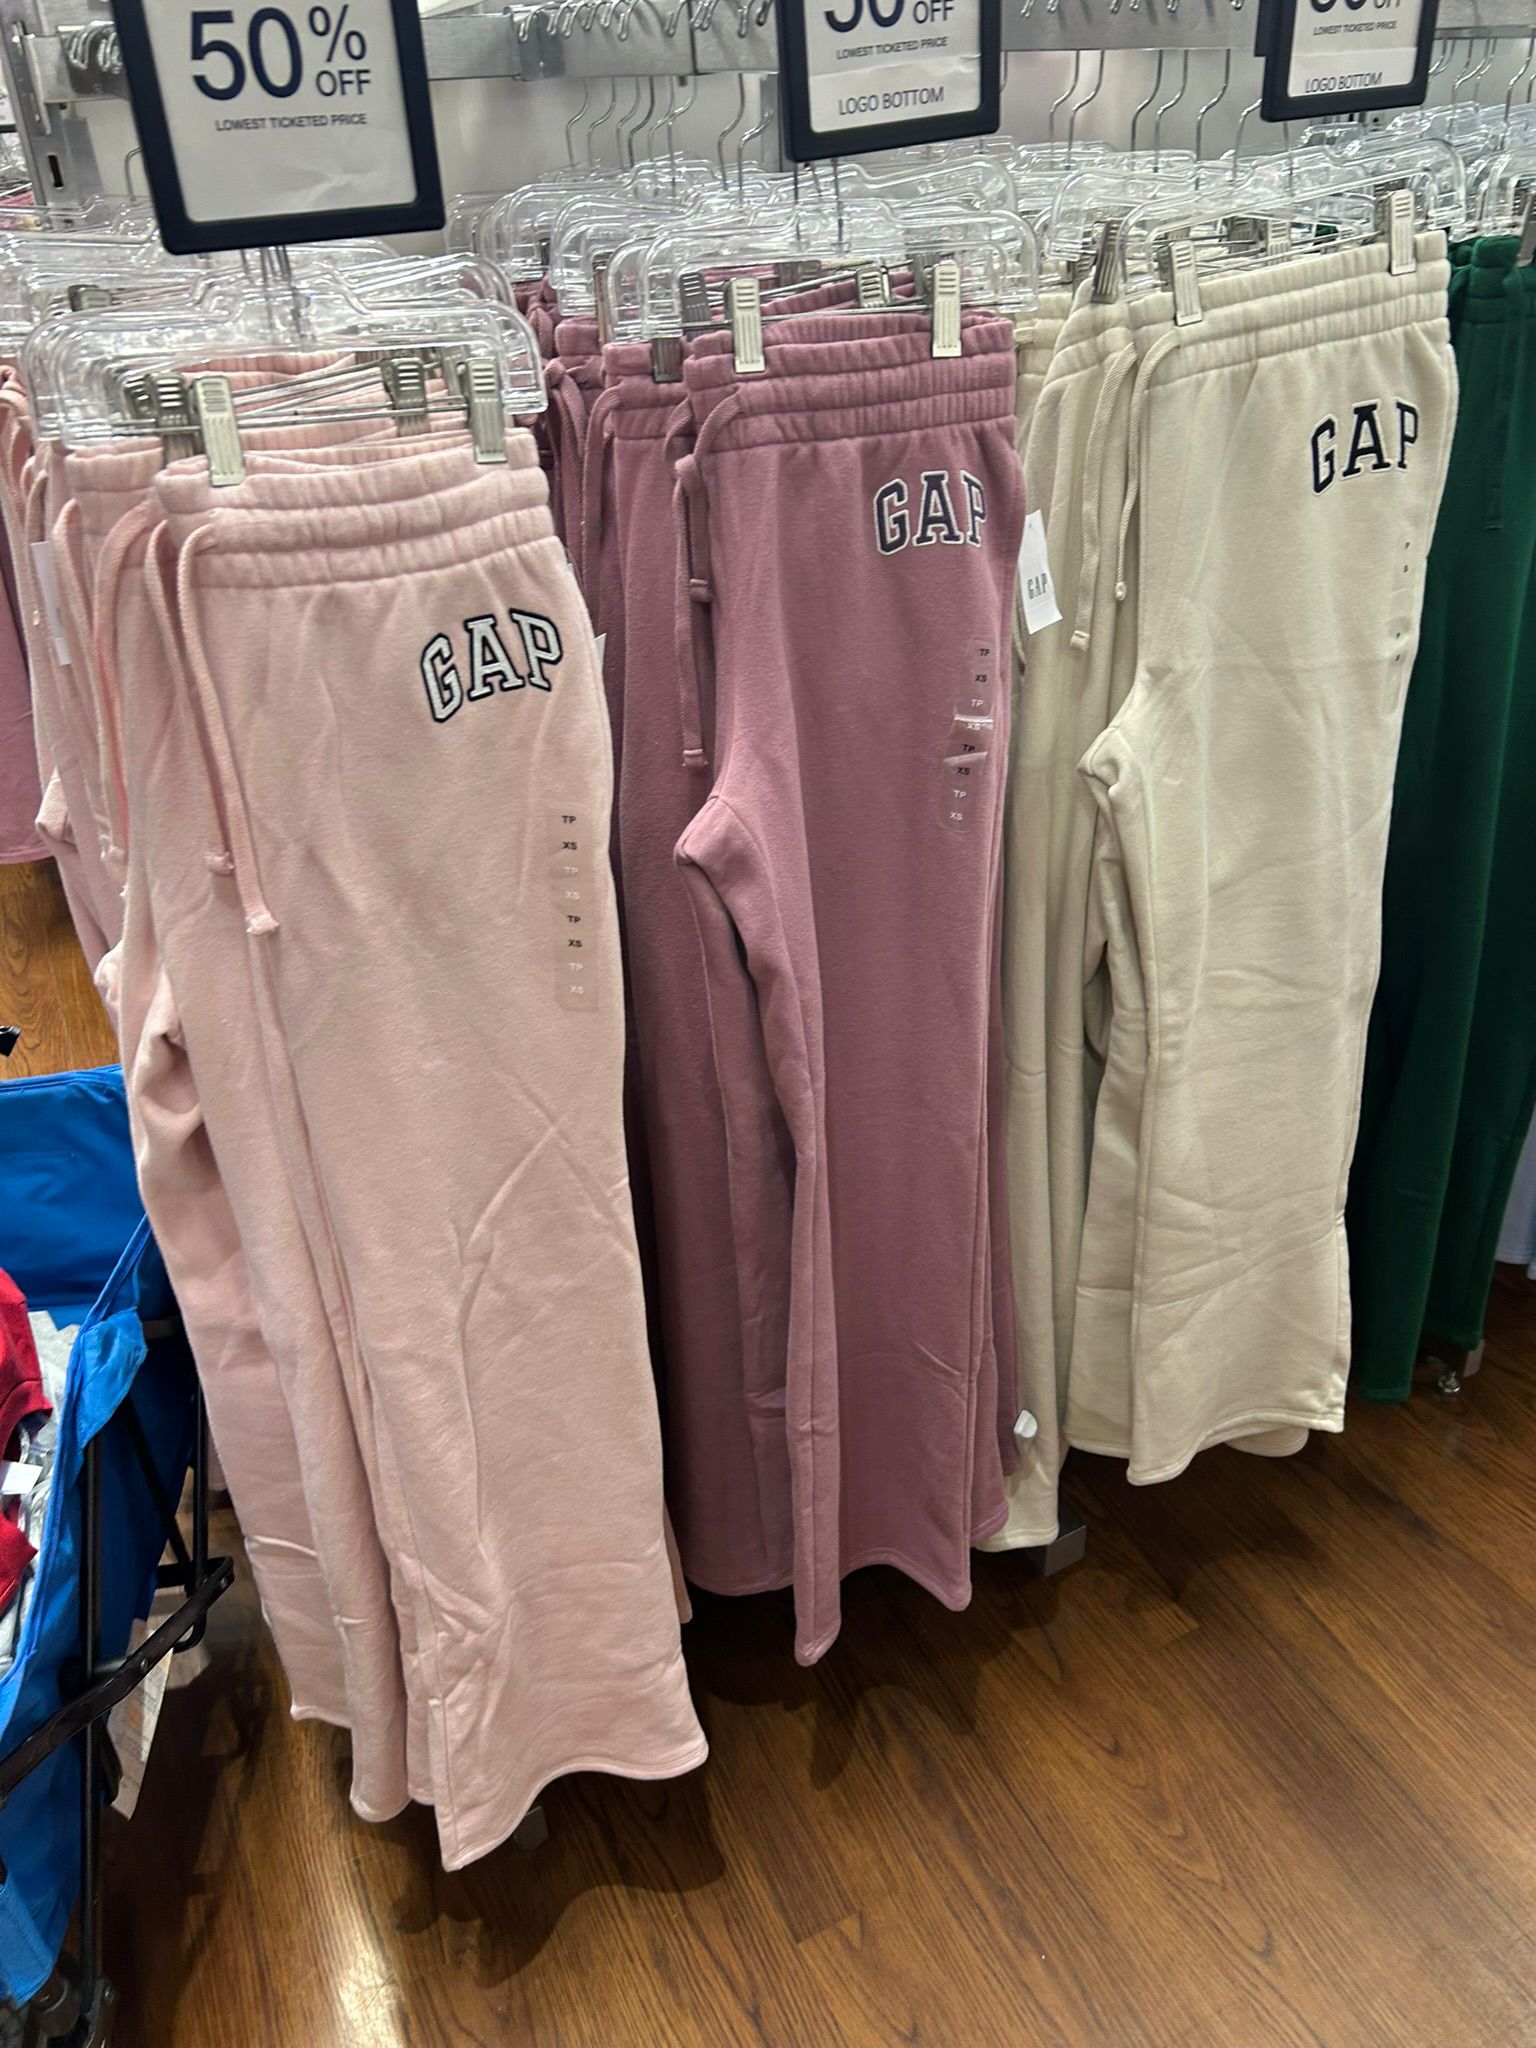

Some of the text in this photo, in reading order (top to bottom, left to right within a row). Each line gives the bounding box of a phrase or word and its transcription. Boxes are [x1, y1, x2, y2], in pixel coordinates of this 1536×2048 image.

[913, 0, 954, 24] OFF
[837, 36, 948, 60] LOWEST TICKETED PRICE
[316, 69, 371, 97] OFF
[1305, 72, 1383, 93] LOGO BOTTOM
[838, 86, 944, 116] LOGO BOTTOM
[215, 112, 367, 132] LOWEST TICKETED PRICE
[1311, 396, 1419, 496] GAP
[873, 469, 988, 556] GAP
[1027, 572, 1048, 600] GAP
[420, 607, 563, 723] GAP
[974, 673, 987, 683] XS
[962, 743, 975, 753] TP
[956, 766, 970, 776] XS
[561, 814, 576, 824] TP
[562, 840, 577, 850] XS
[567, 914, 581, 924] TP
[568, 938, 582, 948] XS
